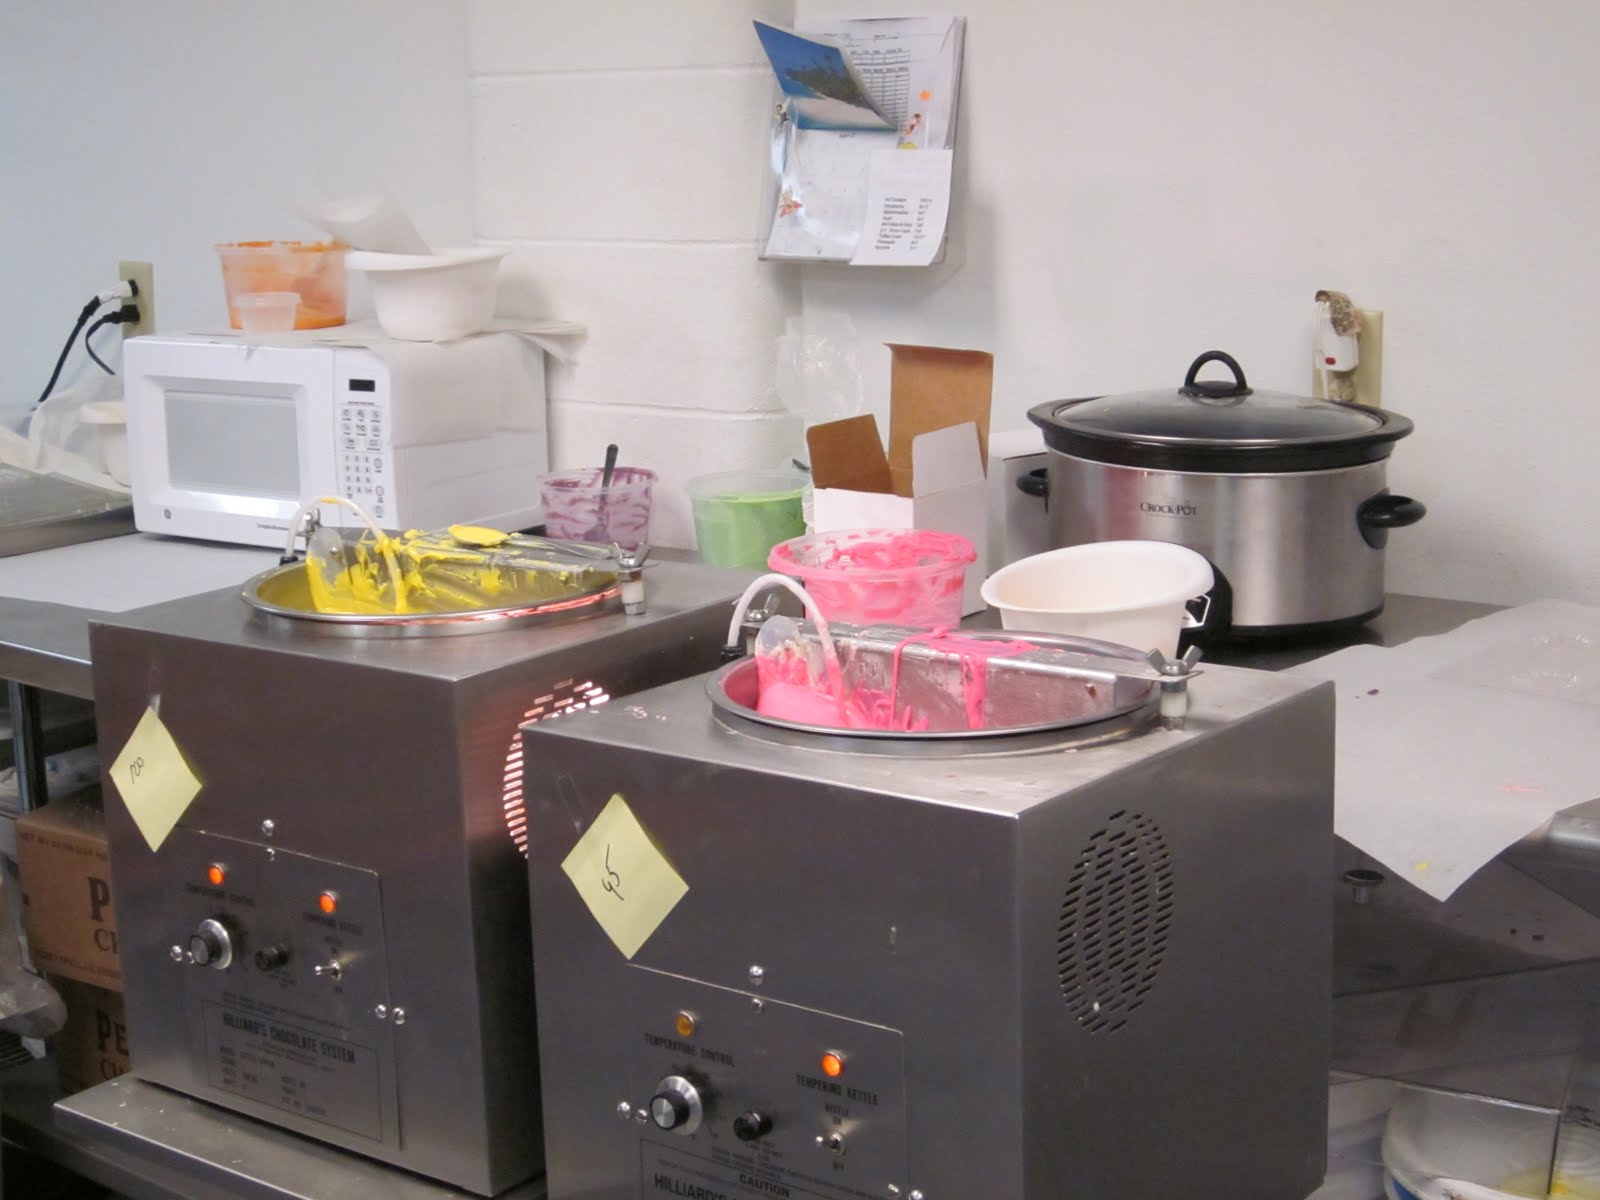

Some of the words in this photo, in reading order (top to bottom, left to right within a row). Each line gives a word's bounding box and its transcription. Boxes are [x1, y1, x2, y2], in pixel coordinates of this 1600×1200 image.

[270, 1024, 319, 1054] CHOCOLATE
[320, 1041, 357, 1066] SYSTEM
[643, 1031, 698, 1057] TEMPERATURE
[700, 1047, 736, 1068] CONTROL
[796, 1073, 842, 1097] TEMPERING
[847, 1087, 880, 1106] KETTLE
[738, 1173, 791, 1199] CAUTION
